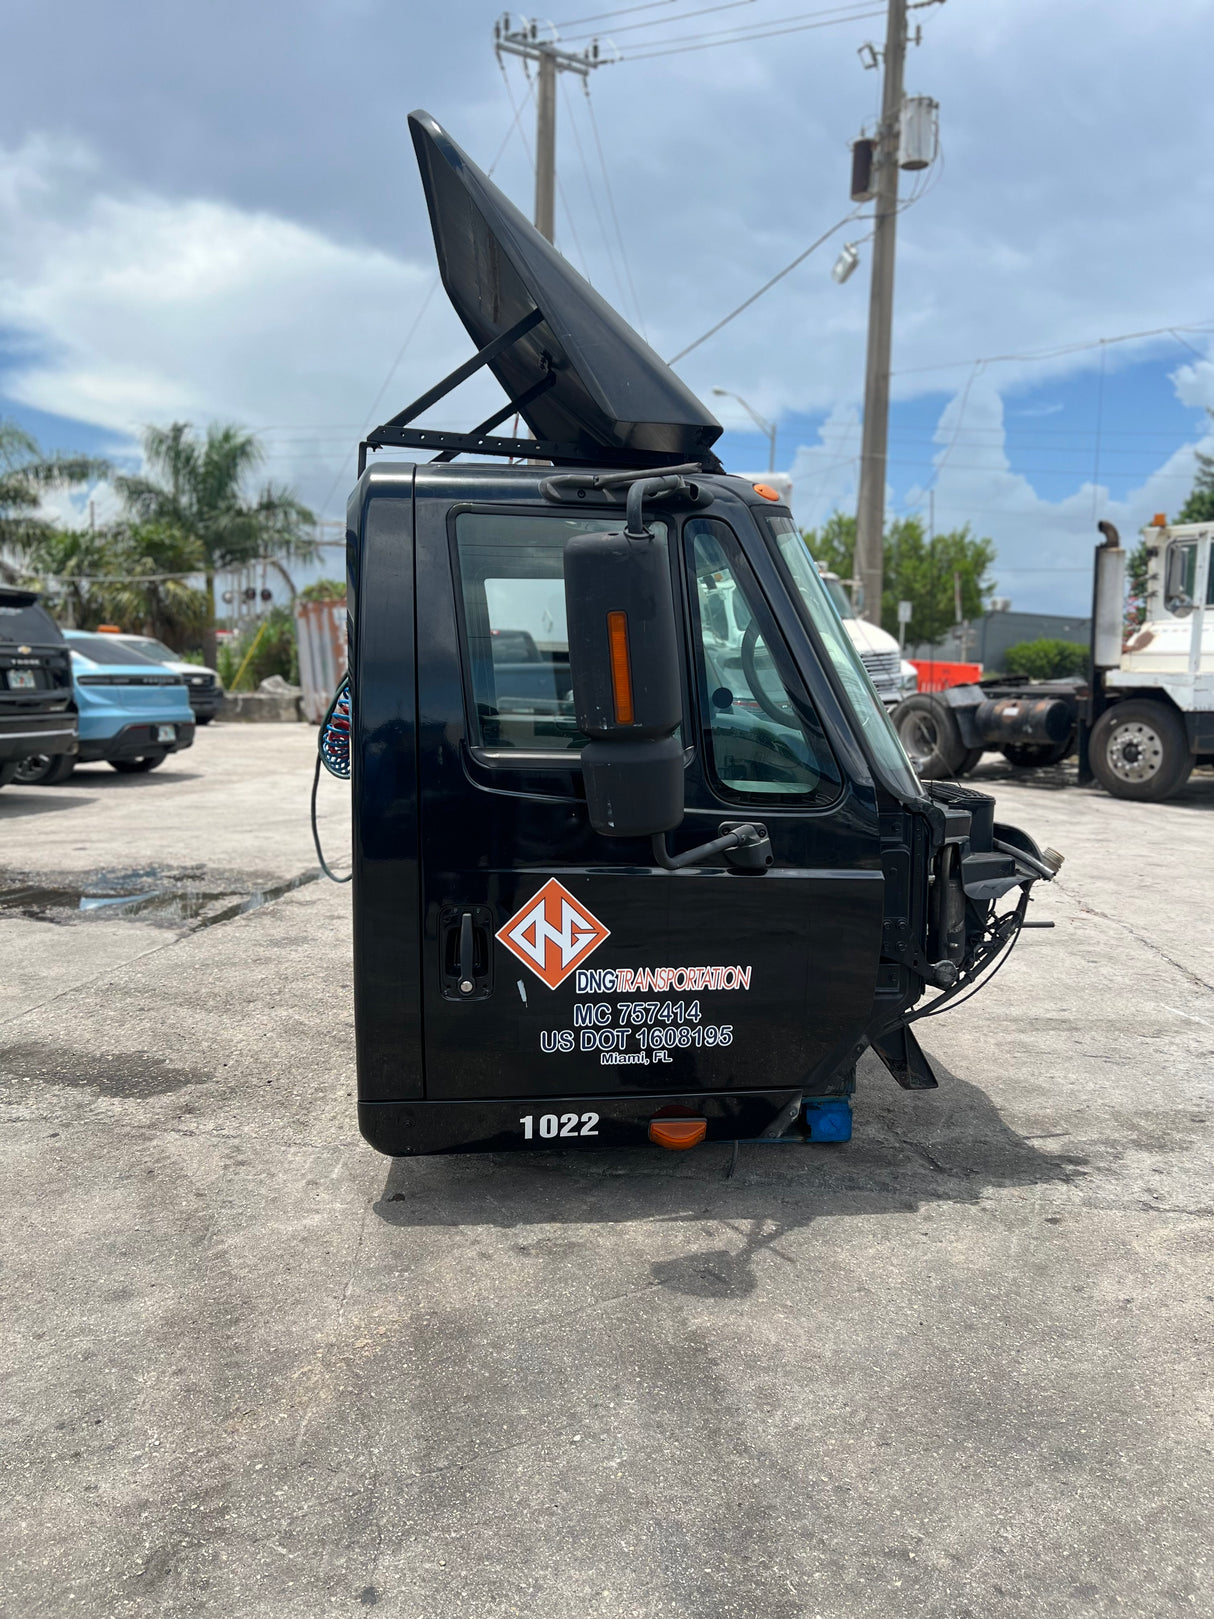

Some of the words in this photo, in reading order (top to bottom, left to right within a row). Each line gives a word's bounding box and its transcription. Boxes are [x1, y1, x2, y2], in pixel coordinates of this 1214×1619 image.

[573, 1003, 611, 1026] MC
[617, 1000, 702, 1025] 757414
[540, 1030, 574, 1052] US
[580, 1028, 631, 1051] DOT
[636, 1025, 733, 1048] 1608195
[600, 1051, 650, 1065] Miami,
[652, 1050, 673, 1063] FL
[519, 1112, 600, 1139] 1022
